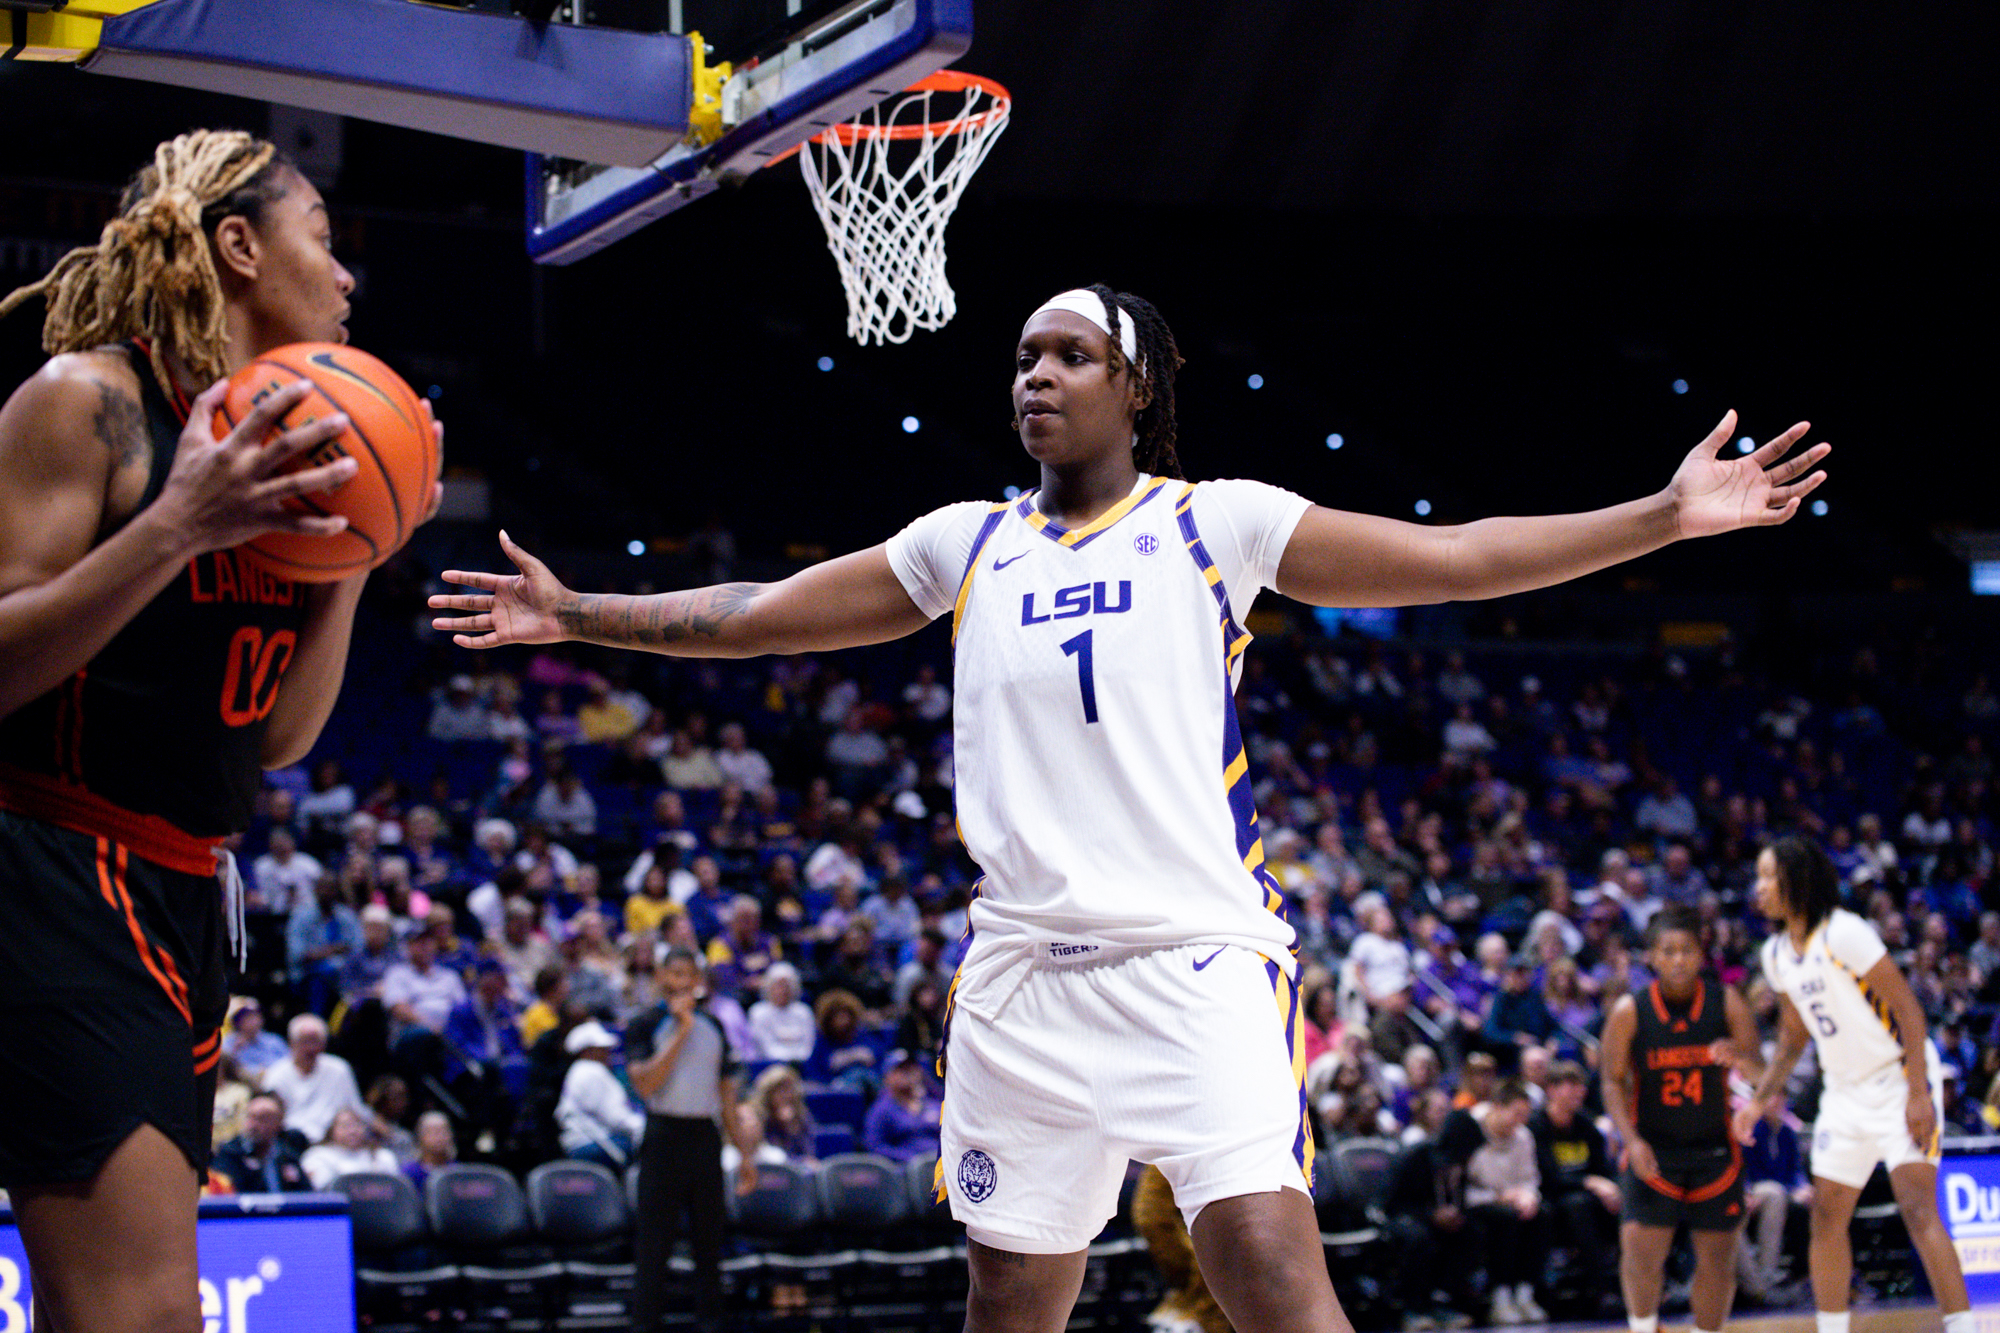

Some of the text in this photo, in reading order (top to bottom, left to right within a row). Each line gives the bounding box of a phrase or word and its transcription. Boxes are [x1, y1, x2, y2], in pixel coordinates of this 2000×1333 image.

[1137, 535, 1156, 553] SEC
[189, 548, 304, 607] LANGS
[1021, 580, 1132, 627] LSU
[219, 626, 297, 728] 00
[1059, 628, 1099, 725] 1
[1661, 1069, 1703, 1107] 24
